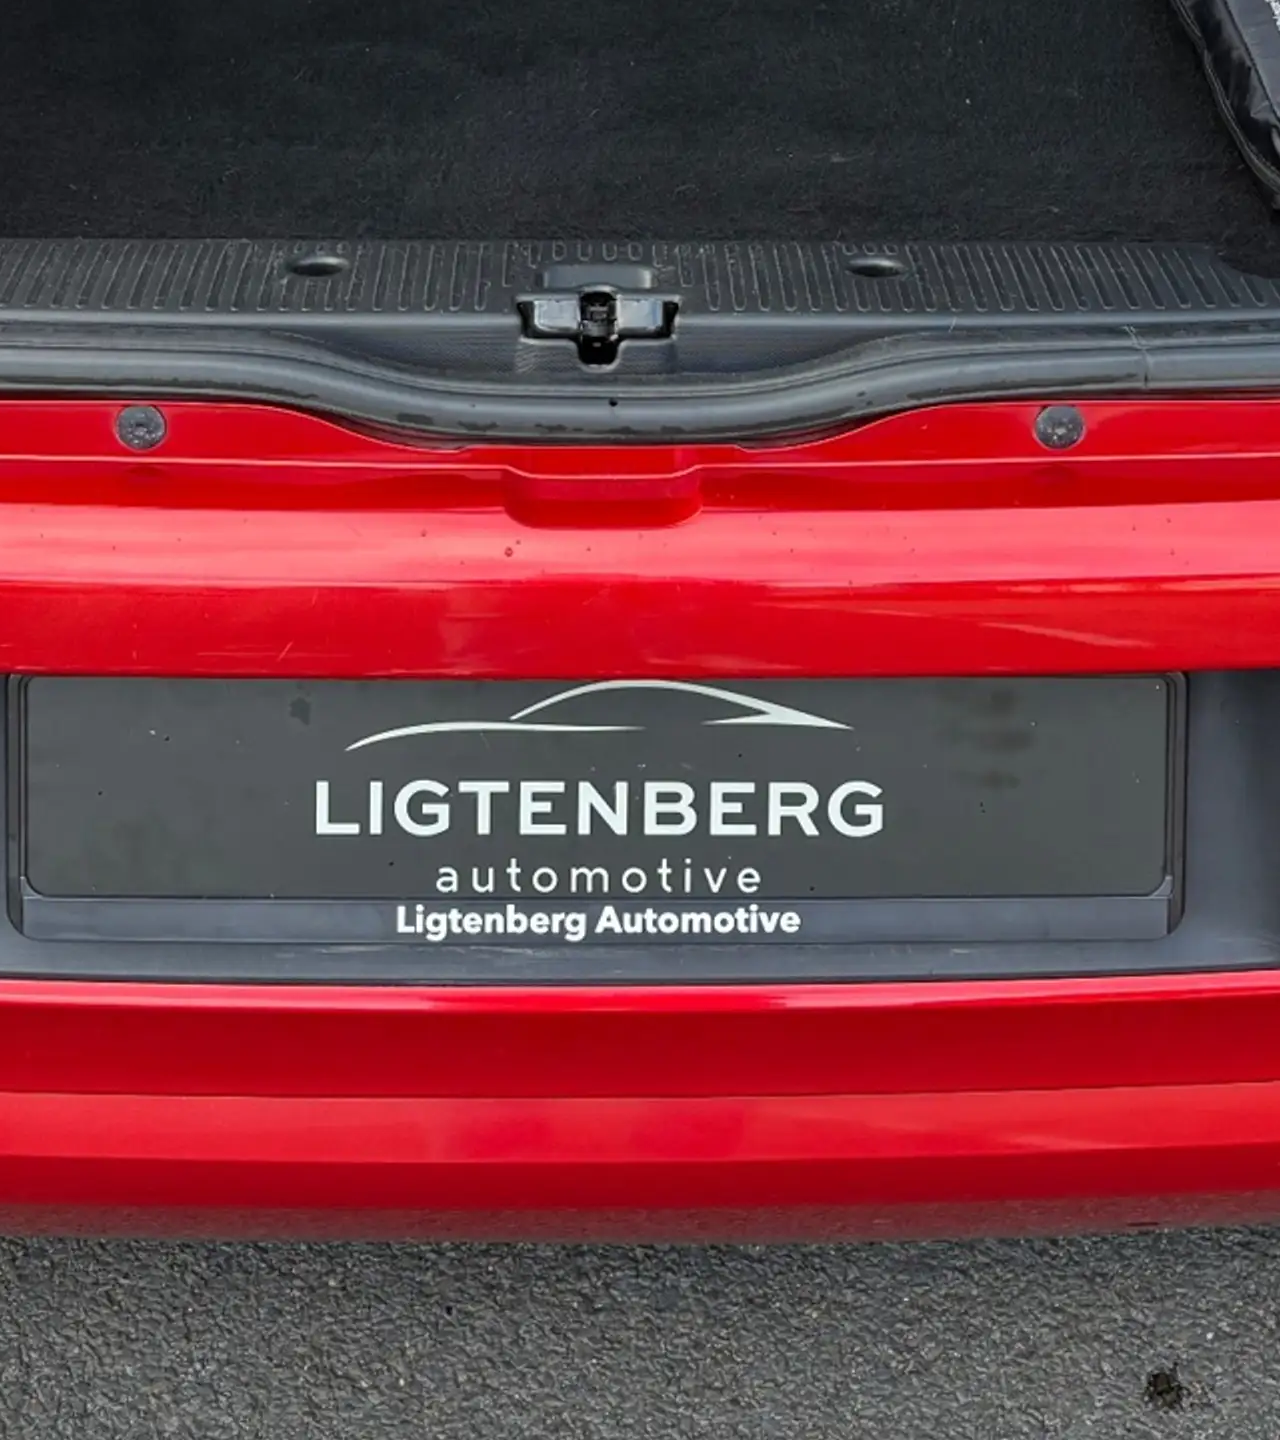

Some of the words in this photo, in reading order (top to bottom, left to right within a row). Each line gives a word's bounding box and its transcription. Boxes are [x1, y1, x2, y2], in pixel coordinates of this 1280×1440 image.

[315, 779, 884, 838] LIGTENBERG
[435, 858, 762, 893] automotive
[397, 904, 587, 942] Ligtenberg
[595, 904, 802, 934] Automotive
